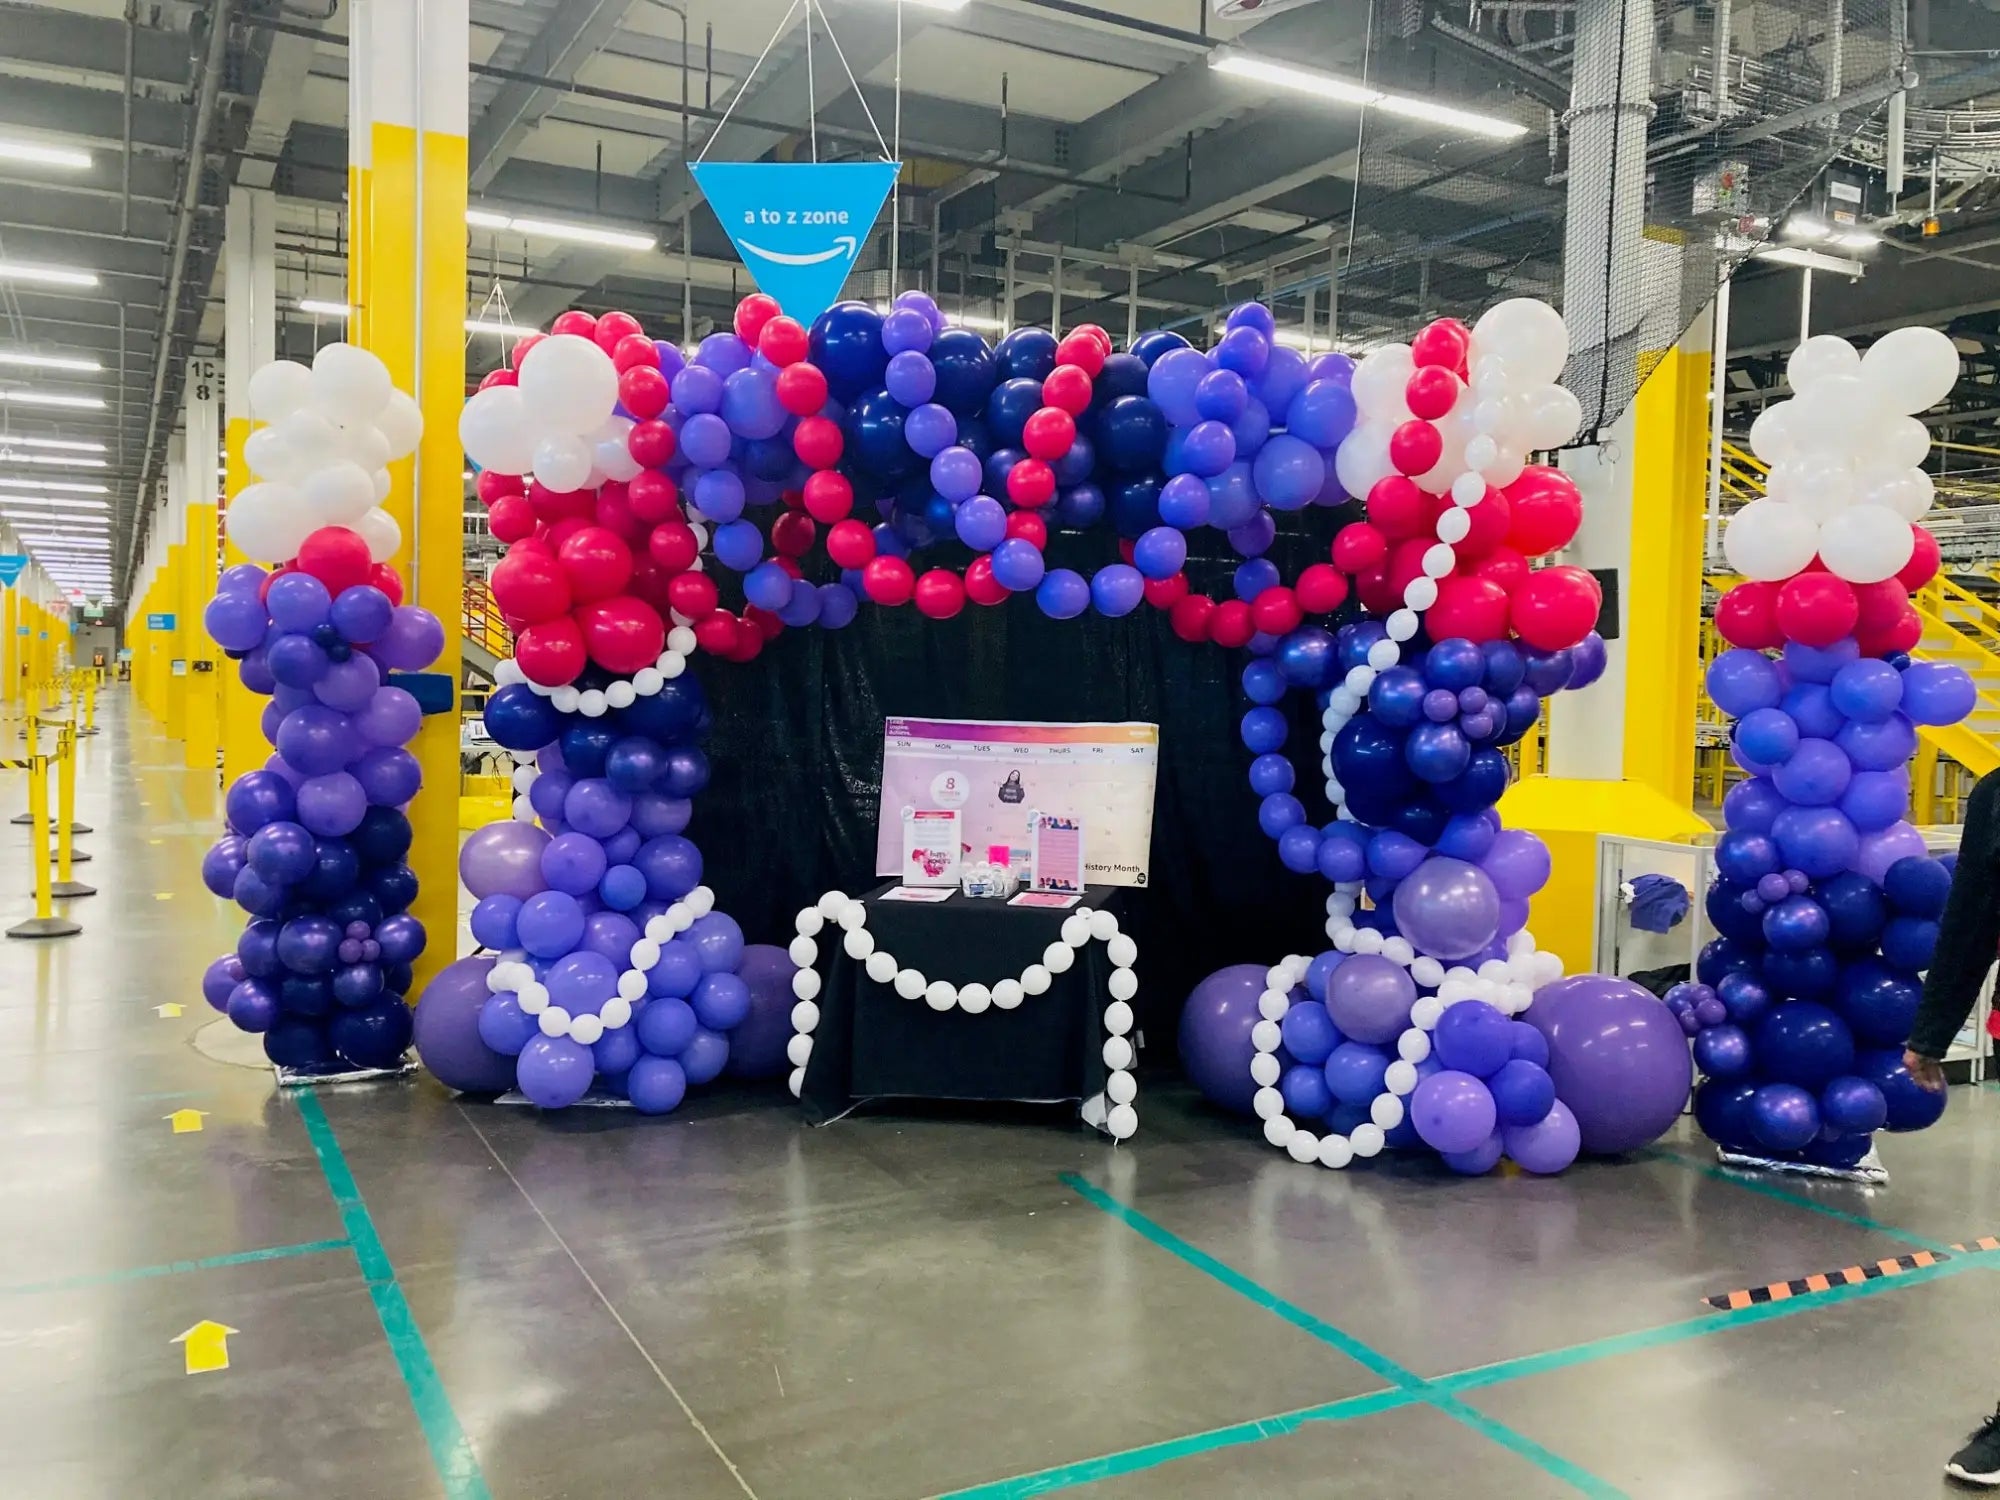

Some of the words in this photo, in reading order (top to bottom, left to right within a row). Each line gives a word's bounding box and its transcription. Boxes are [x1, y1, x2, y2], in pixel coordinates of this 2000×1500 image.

[744, 210, 755, 224] a
[760, 208, 781, 224] to
[786, 210, 797, 224] z
[802, 210, 849, 224] zone
[191, 361, 214, 378] 1C
[196, 384, 210, 400] 8
[945, 777, 955, 790] 8
[1113, 864, 1140, 872] Month
